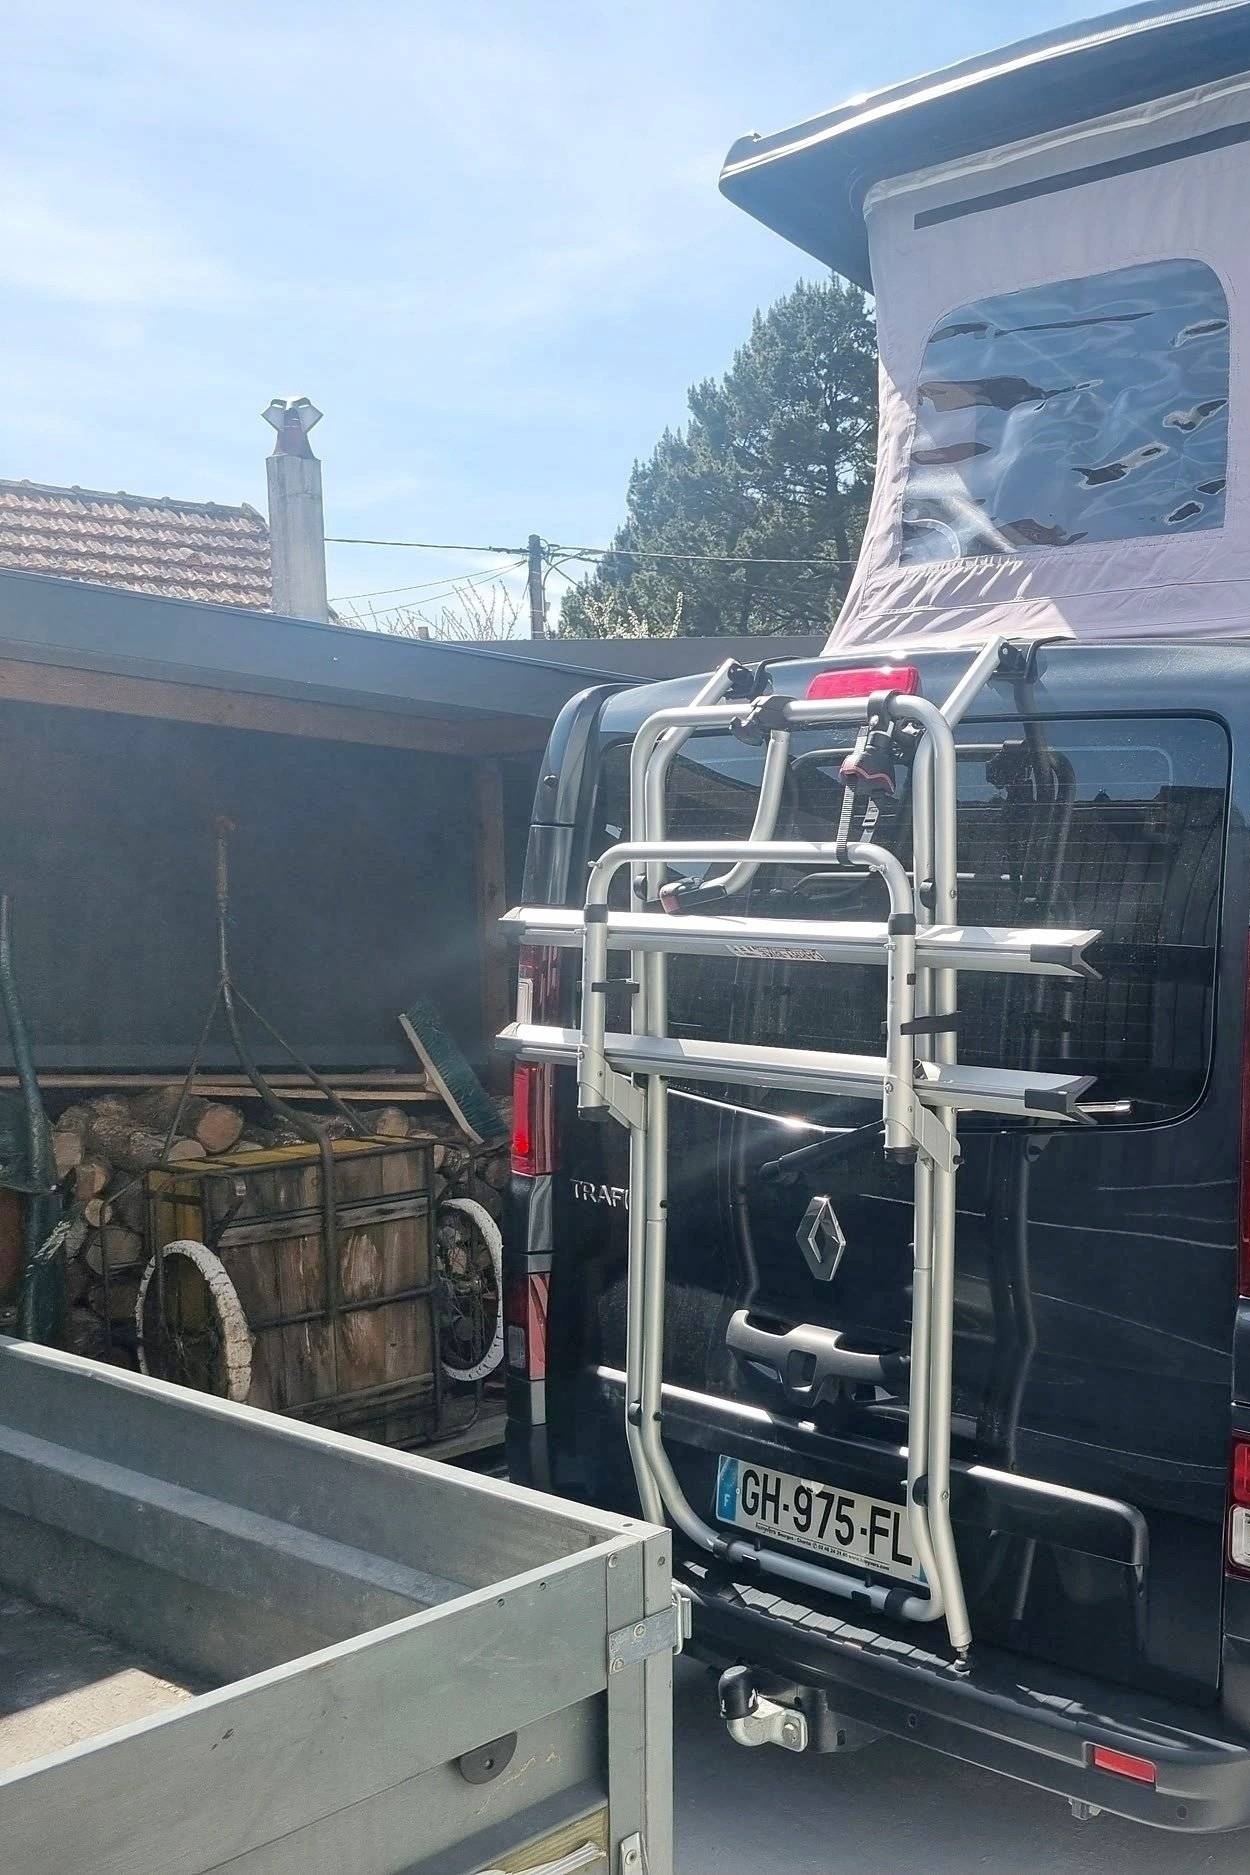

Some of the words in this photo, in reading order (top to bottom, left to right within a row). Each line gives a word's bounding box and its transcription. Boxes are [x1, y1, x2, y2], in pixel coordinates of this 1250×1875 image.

[570, 1178, 630, 1210] TRAFI
[724, 1493, 731, 1507] F
[741, 1469, 913, 1567] GH-975-FL
